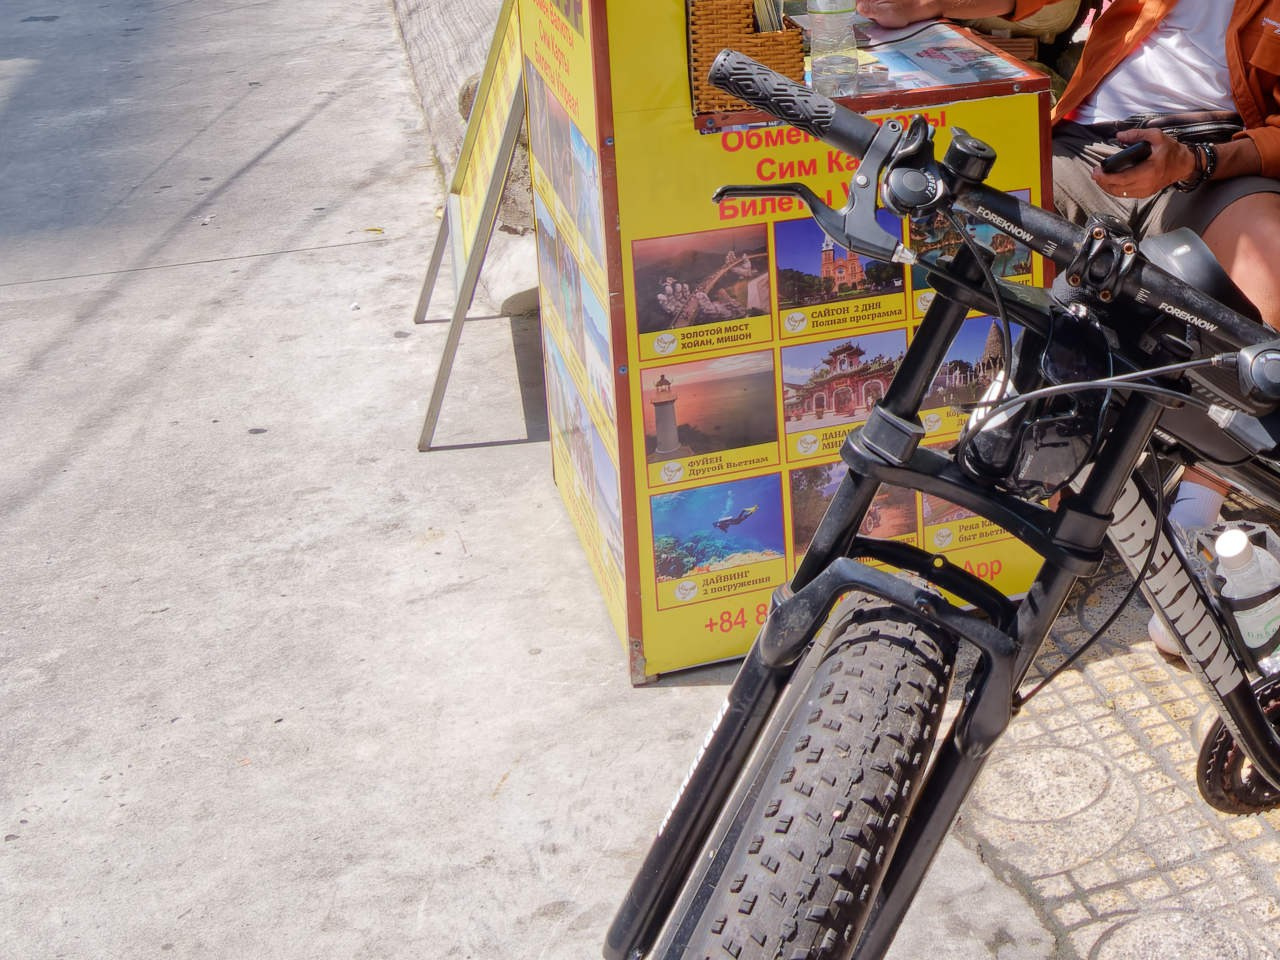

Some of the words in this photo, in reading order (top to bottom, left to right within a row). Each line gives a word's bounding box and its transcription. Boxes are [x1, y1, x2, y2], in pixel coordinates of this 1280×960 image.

[756, 155, 818, 182] Сим
[976, 206, 1034, 242] FOREKNOW
[810, 306, 850, 320] САЙГОН
[854, 303, 860, 313] 2
[861, 301, 882, 313] ДНЯ
[811, 316, 847, 329] Полная
[849, 309, 903, 325] программа
[1159, 302, 1219, 333] FOREKNOW
[680, 326, 723, 340] ЗОЛОТОЙ
[725, 323, 750, 335] МОСТ
[681, 337, 715, 350] ХОЙАН,
[716, 332, 752, 345] МИШОН
[687, 455, 723, 468] ФУЙЕН
[688, 464, 724, 477] Другой
[726, 456, 769, 470] Вьетнам
[958, 521, 980, 533] Река
[958, 532, 977, 543] быт
[702, 569, 750, 588] ДАЙВИНГ
[702, 588, 709, 596] 2
[711, 576, 771, 594] погружения
[1108, 470, 1244, 696] OREKNOW
[705, 607, 748, 633] +84
[755, 603, 769, 625] 8
